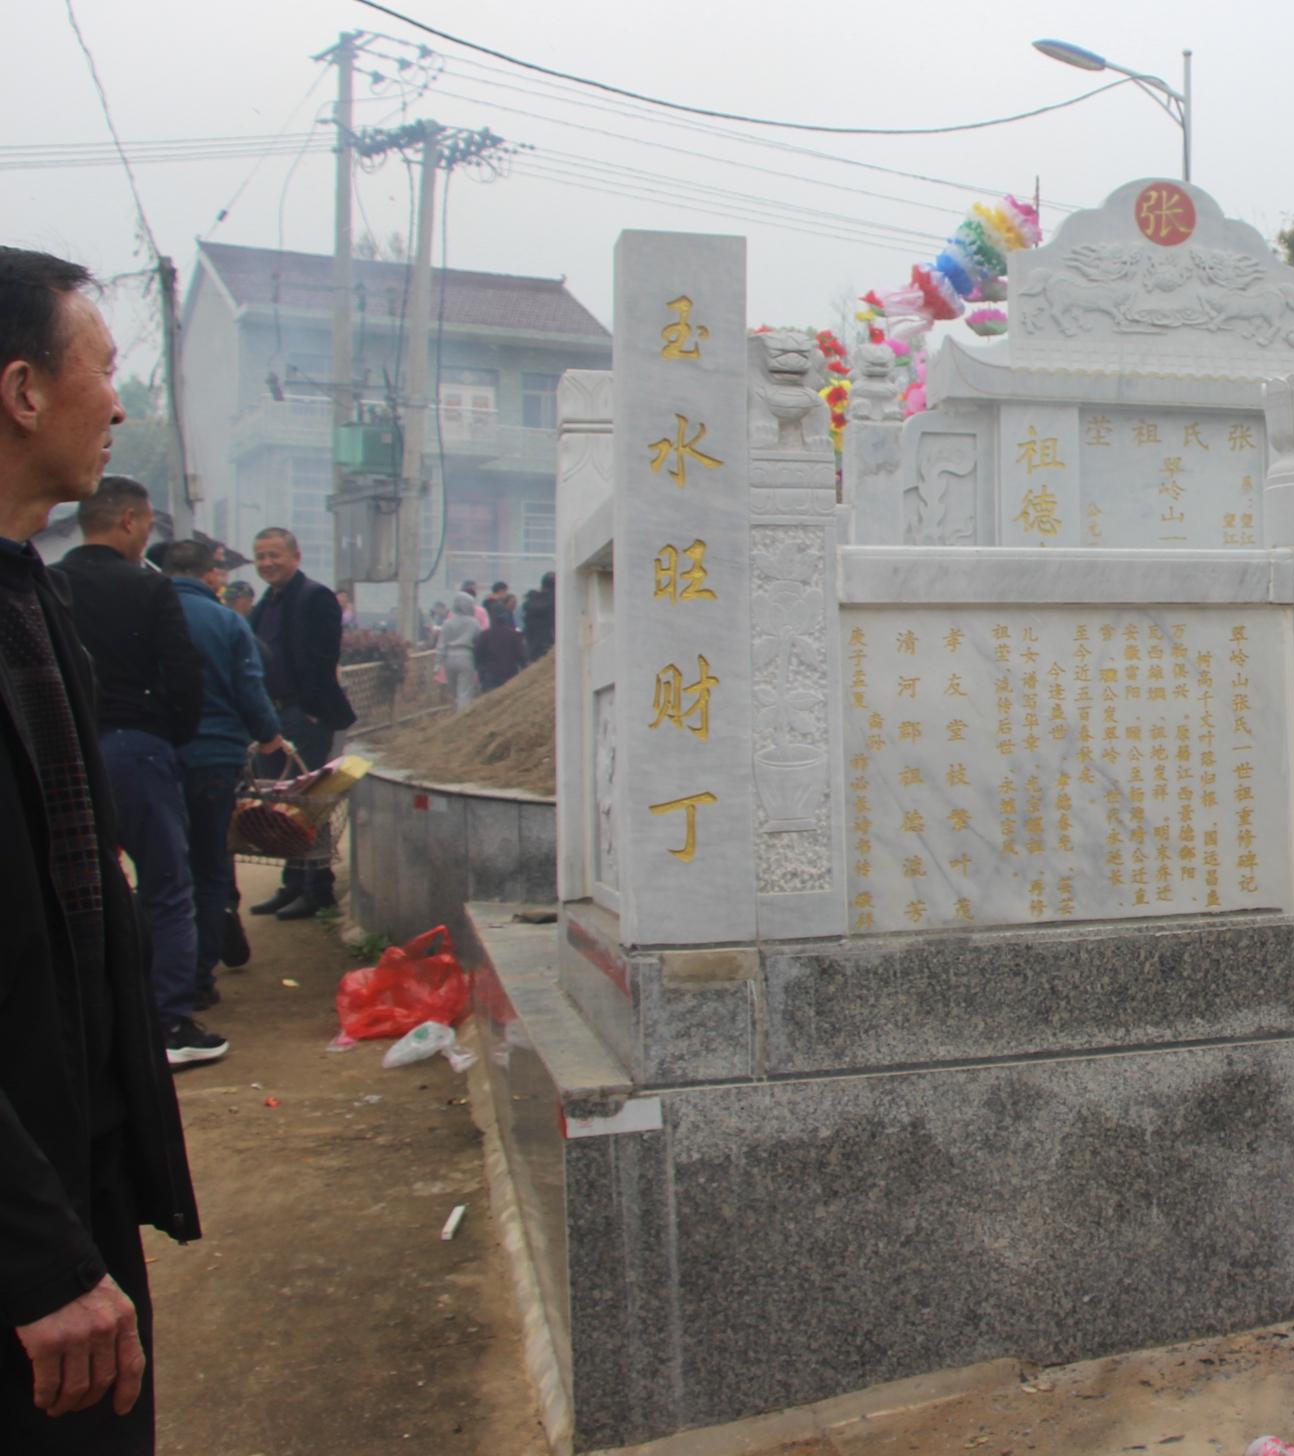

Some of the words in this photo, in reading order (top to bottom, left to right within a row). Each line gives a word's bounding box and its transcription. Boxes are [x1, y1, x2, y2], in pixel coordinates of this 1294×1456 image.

[1141, 190, 1192, 237] 张
[1011, 424, 1067, 547] 祖德
[647, 294, 725, 865] 玉水旺财丁
